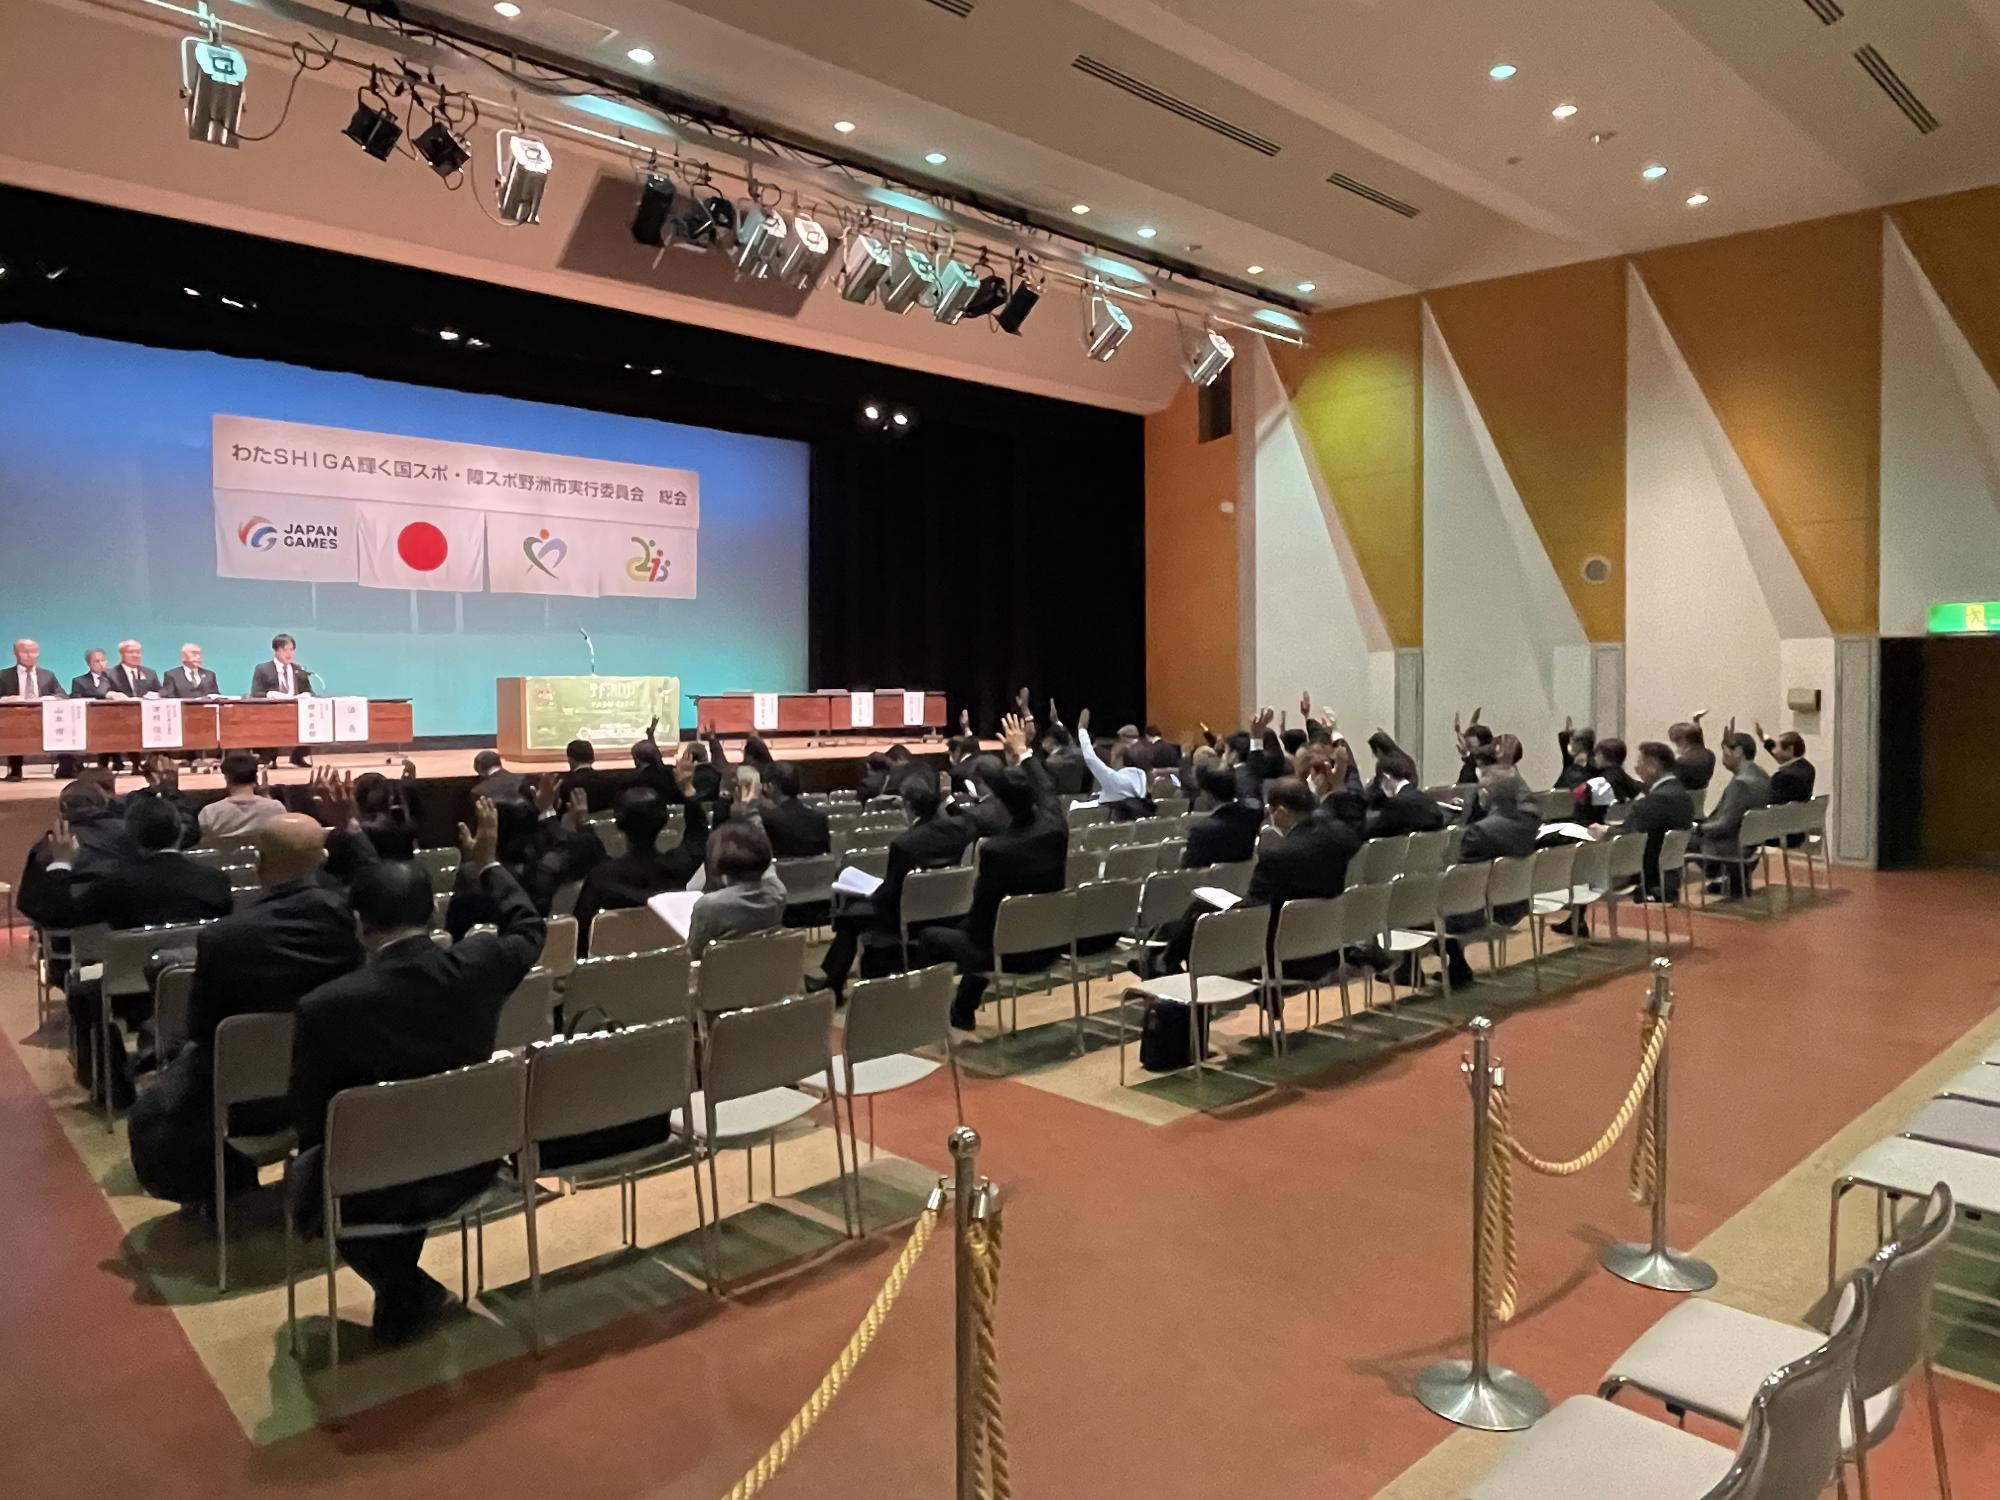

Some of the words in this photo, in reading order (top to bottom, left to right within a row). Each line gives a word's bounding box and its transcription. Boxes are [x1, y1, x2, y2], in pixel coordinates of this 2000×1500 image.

[658, 488, 688, 507] 総会
[283, 523, 338, 537] JAPAN
[283, 535, 338, 549] GAMES
